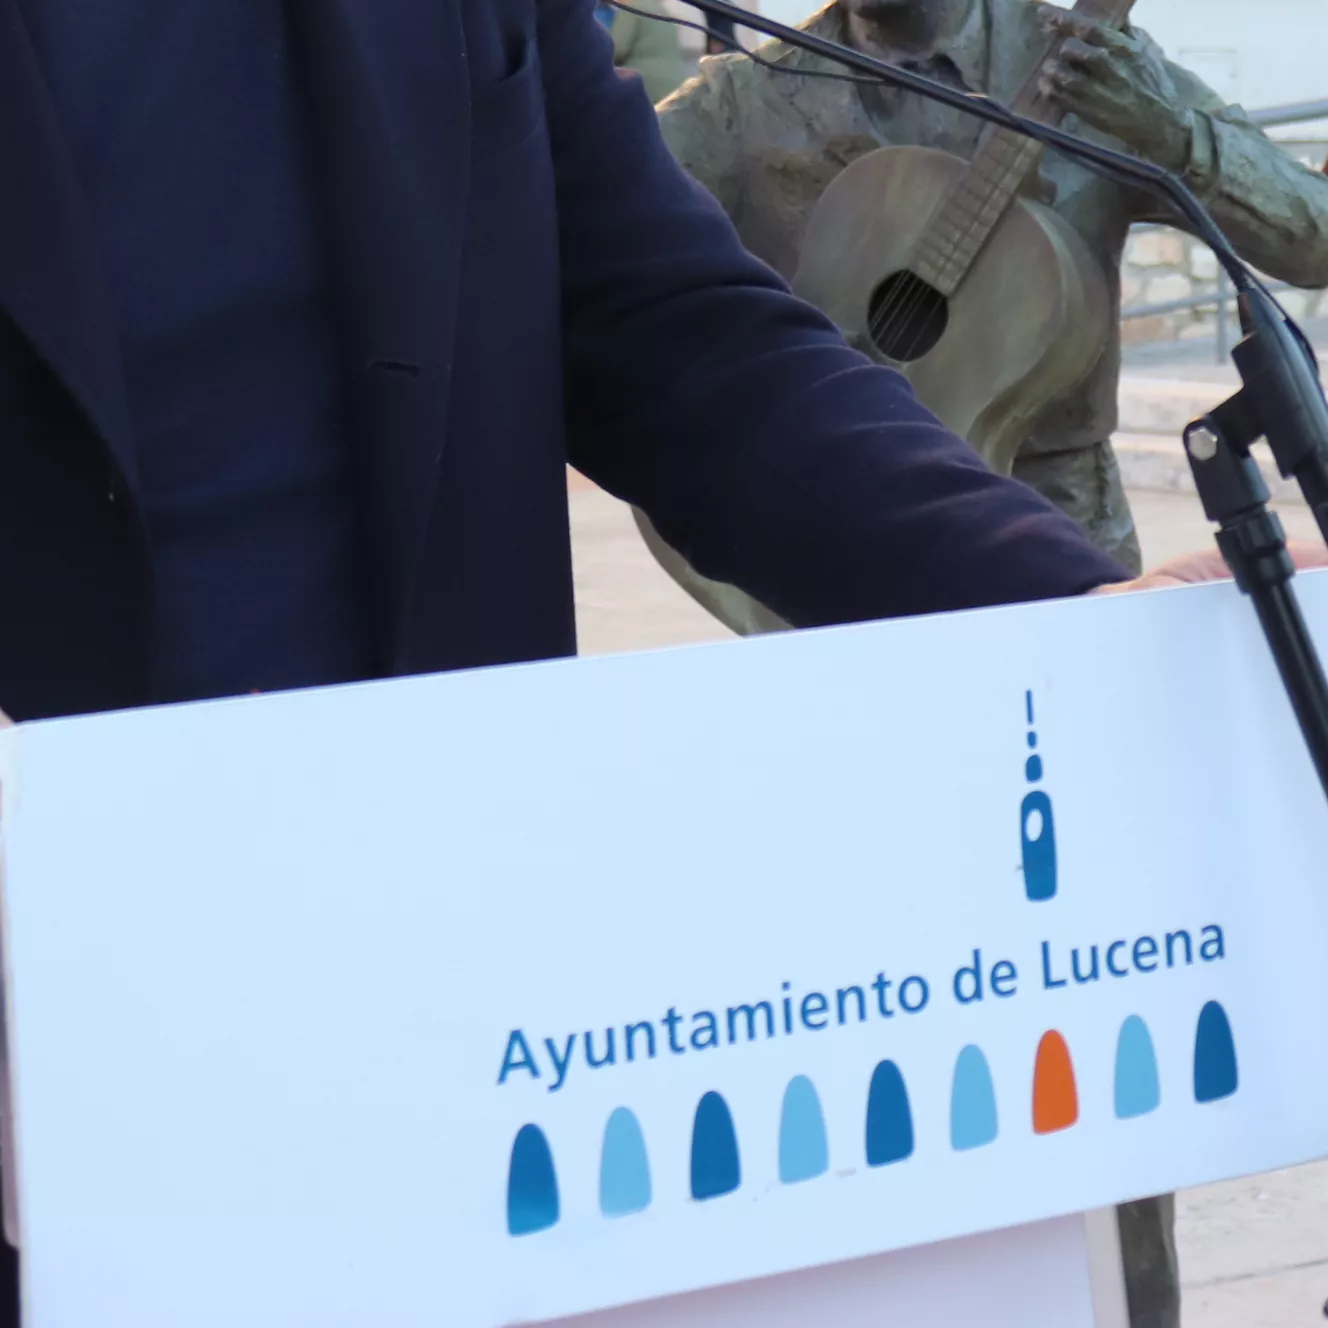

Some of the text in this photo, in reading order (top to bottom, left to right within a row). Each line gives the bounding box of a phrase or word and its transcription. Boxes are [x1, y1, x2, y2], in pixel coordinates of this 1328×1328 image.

[497, 923, 1226, 1093] Ayuntamiento de Lucena
